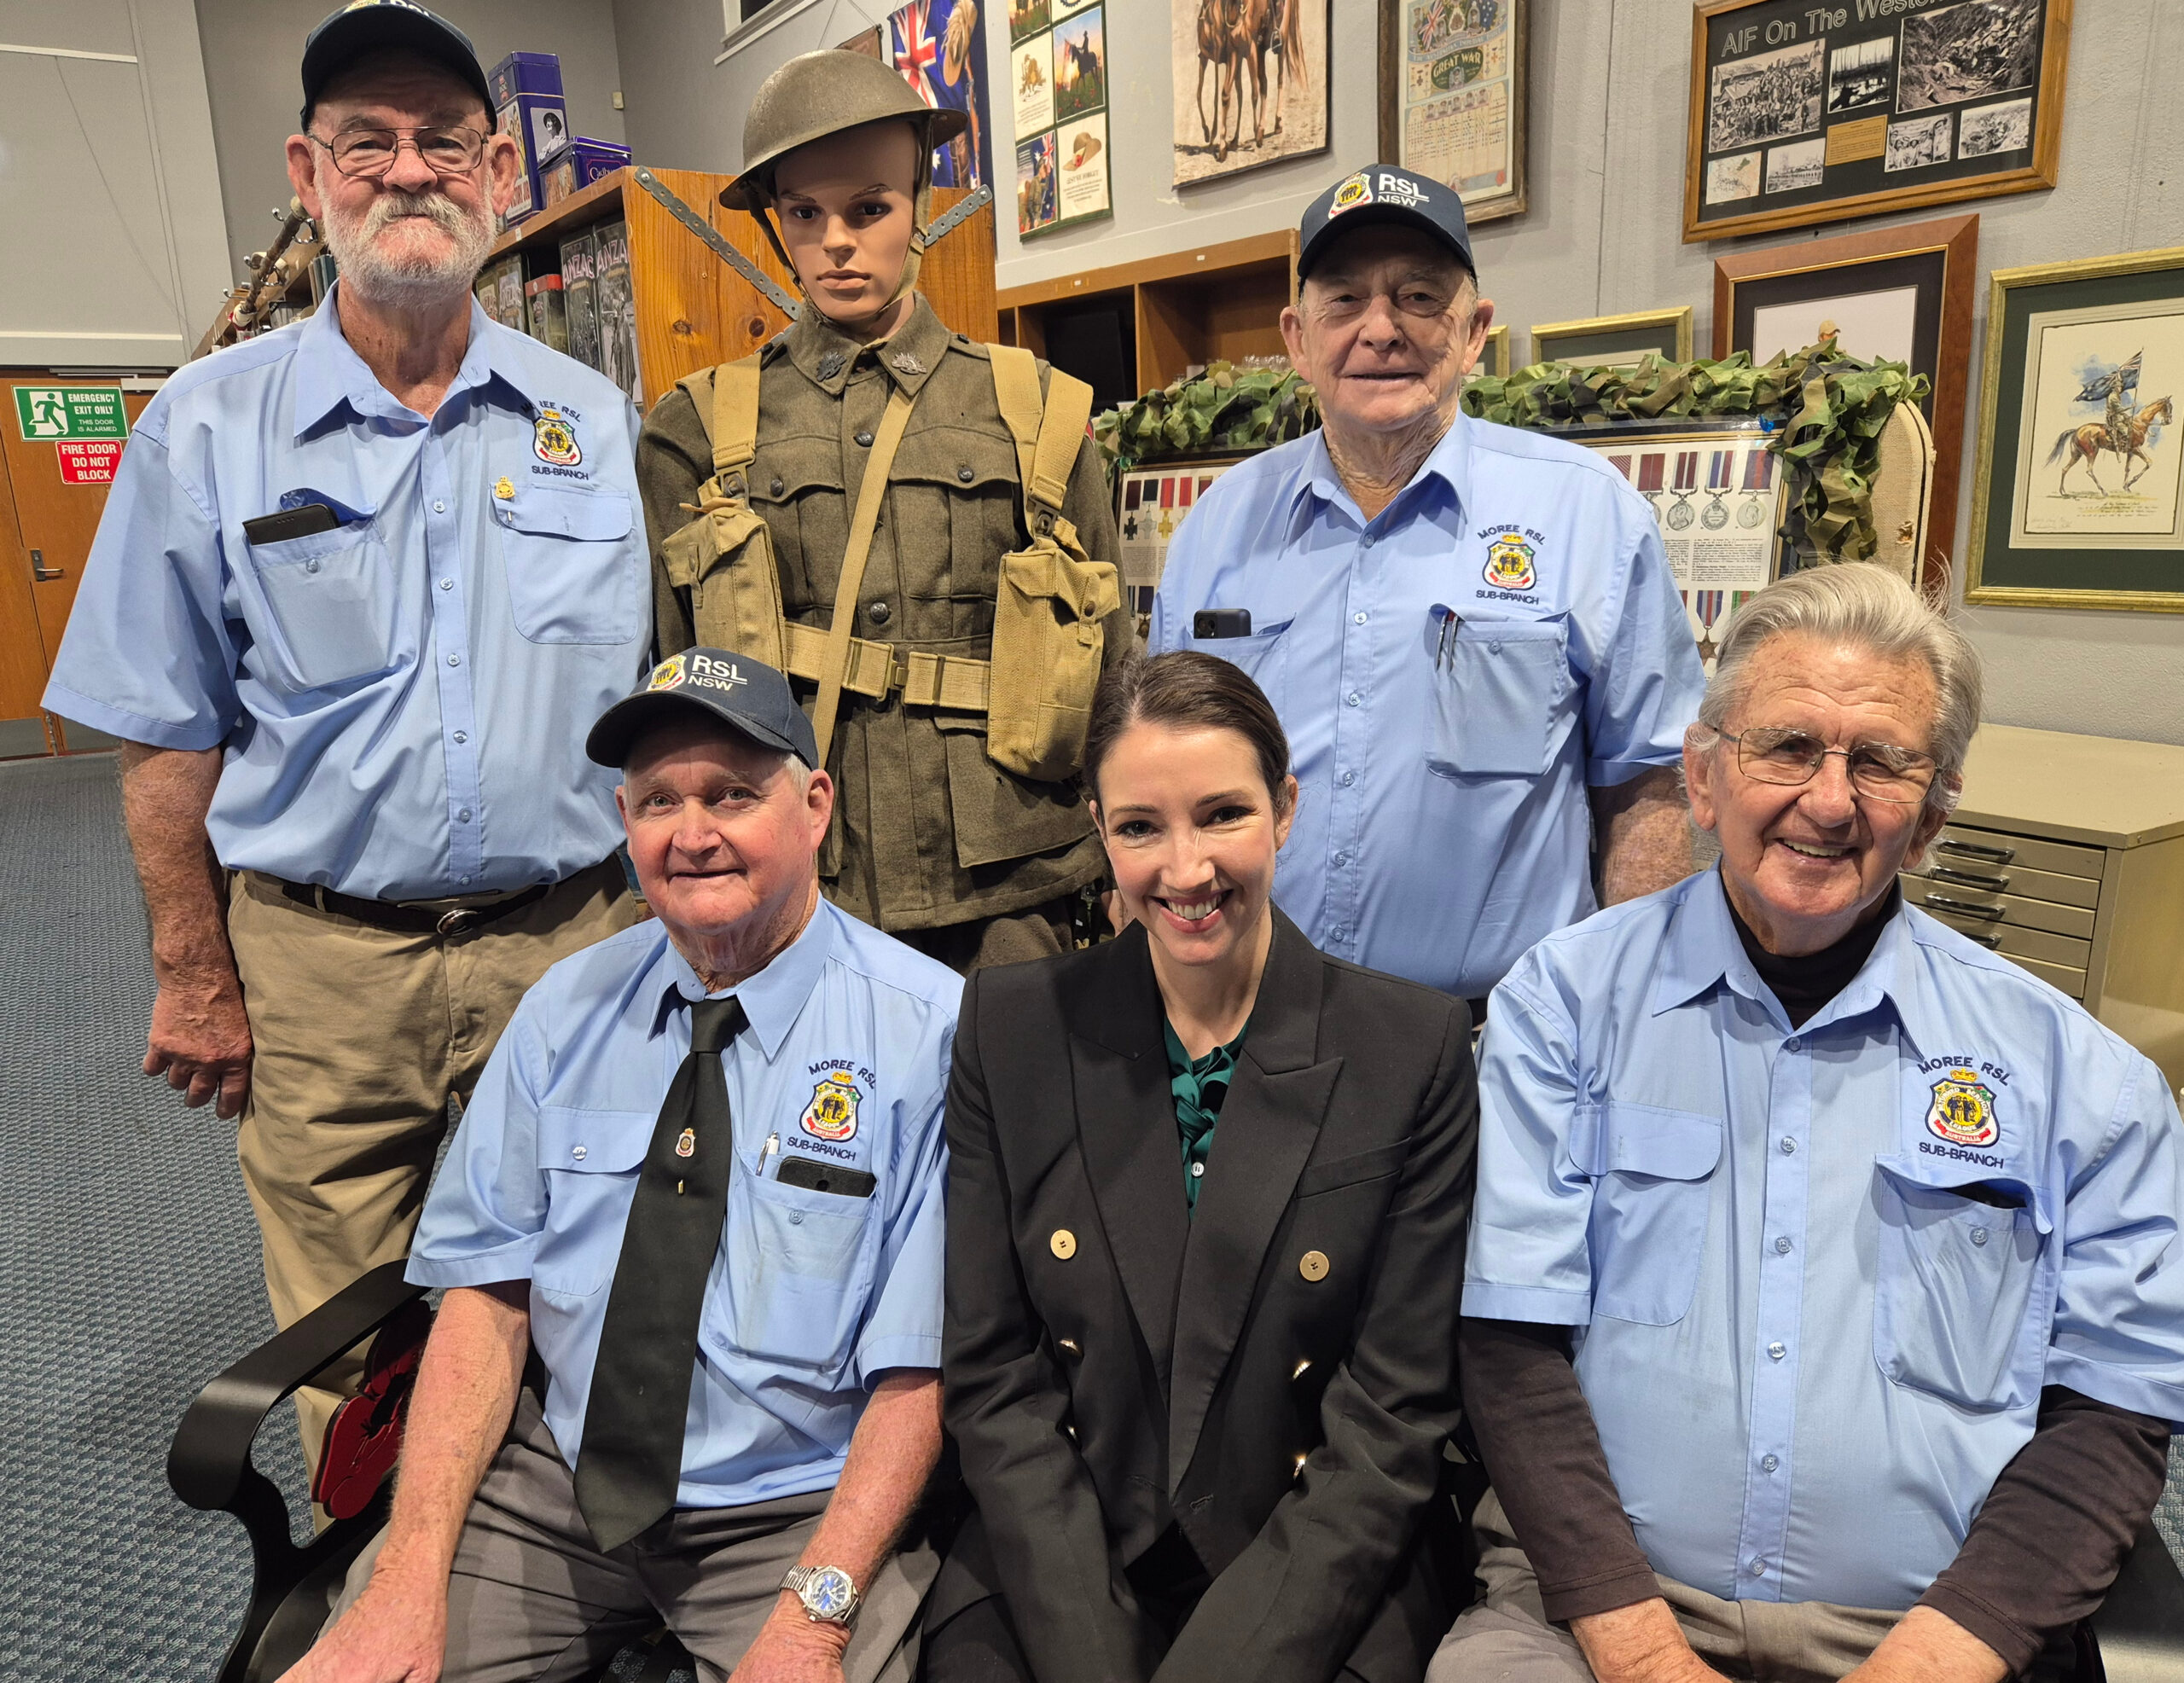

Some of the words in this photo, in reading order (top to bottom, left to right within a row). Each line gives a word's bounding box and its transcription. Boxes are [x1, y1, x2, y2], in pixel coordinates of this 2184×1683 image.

[1721, 26, 1758, 57] AIF
[1765, 20, 1797, 44] On
[1804, 8, 1847, 34] The
[1433, 55, 1460, 78] GREAT
[1461, 52, 1481, 65] WAR
[1379, 173, 1430, 200] RSL
[1377, 194, 1417, 207] NSW
[597, 239, 628, 278] ANZA
[562, 253, 595, 290] ANZAC
[68, 393, 115, 403] EMERGENCY
[74, 405, 92, 415] EXIT
[95, 405, 113, 415] ONLY
[561, 405, 581, 422] RSL
[61, 444, 84, 455] FIRE
[87, 444, 117, 454] DOOR
[72, 457, 87, 467] DO
[90, 456, 110, 467] NOT
[77, 470, 112, 480] BLOCK
[531, 466, 589, 480] SUB-BRANCH
[1477, 525, 1519, 539] MOREE
[1525, 528, 1546, 545] RSL
[1476, 589, 1539, 605] SUB-BRANCH
[692, 654, 747, 682] RSL
[688, 675, 733, 691] NSW
[808, 1059, 855, 1075] MOREE
[857, 1067, 876, 1089] RSL
[1917, 1056, 1973, 1075] MOREE
[1980, 1061, 2011, 1086] RSL
[1945, 1131, 1981, 1141] AUSTRALIA
[787, 1136, 857, 1161] SUB-BRANCH
[1919, 1142, 2004, 1169] SUB-BRANCH
